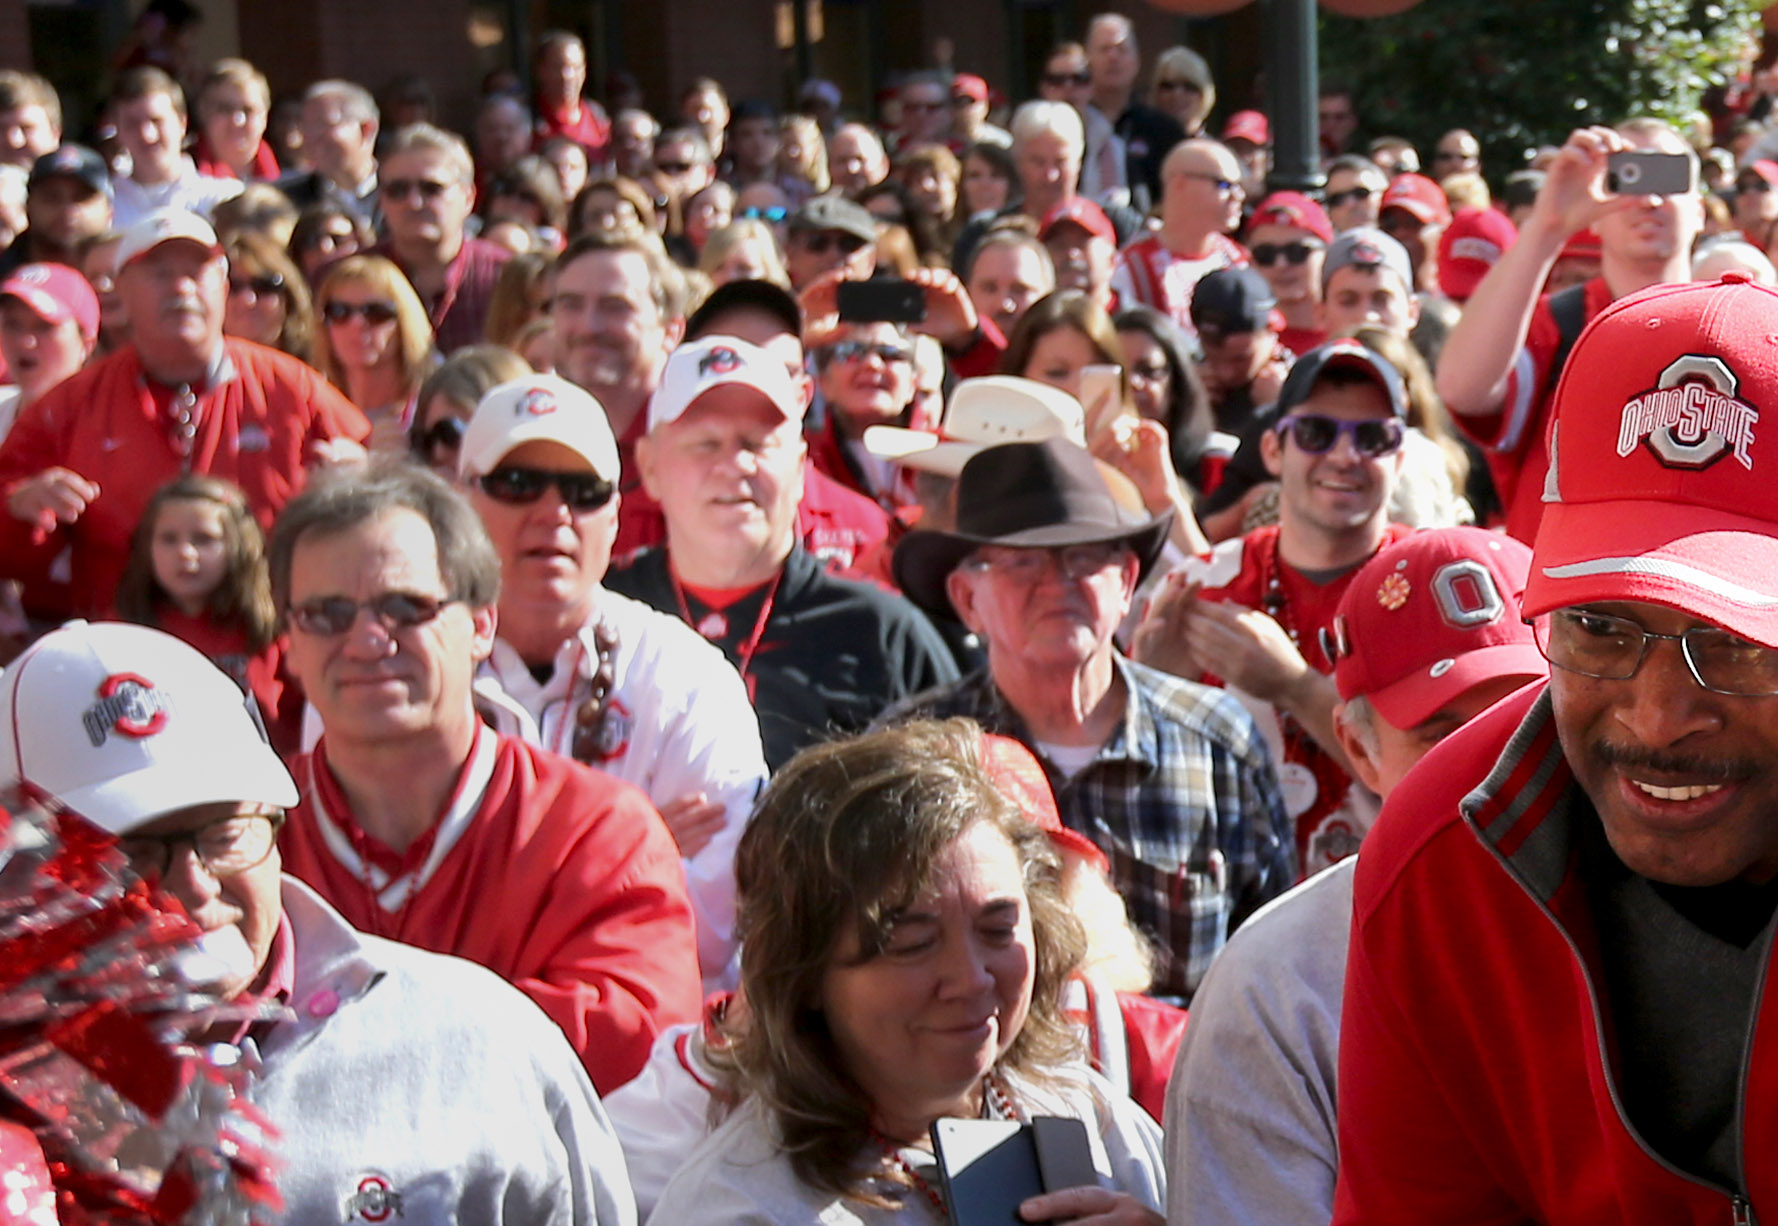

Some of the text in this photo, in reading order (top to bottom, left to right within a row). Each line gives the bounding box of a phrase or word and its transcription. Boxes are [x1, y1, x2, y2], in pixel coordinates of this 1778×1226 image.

[1616, 382, 1760, 472] OHIO STATE
[1430, 557, 1506, 629] O
